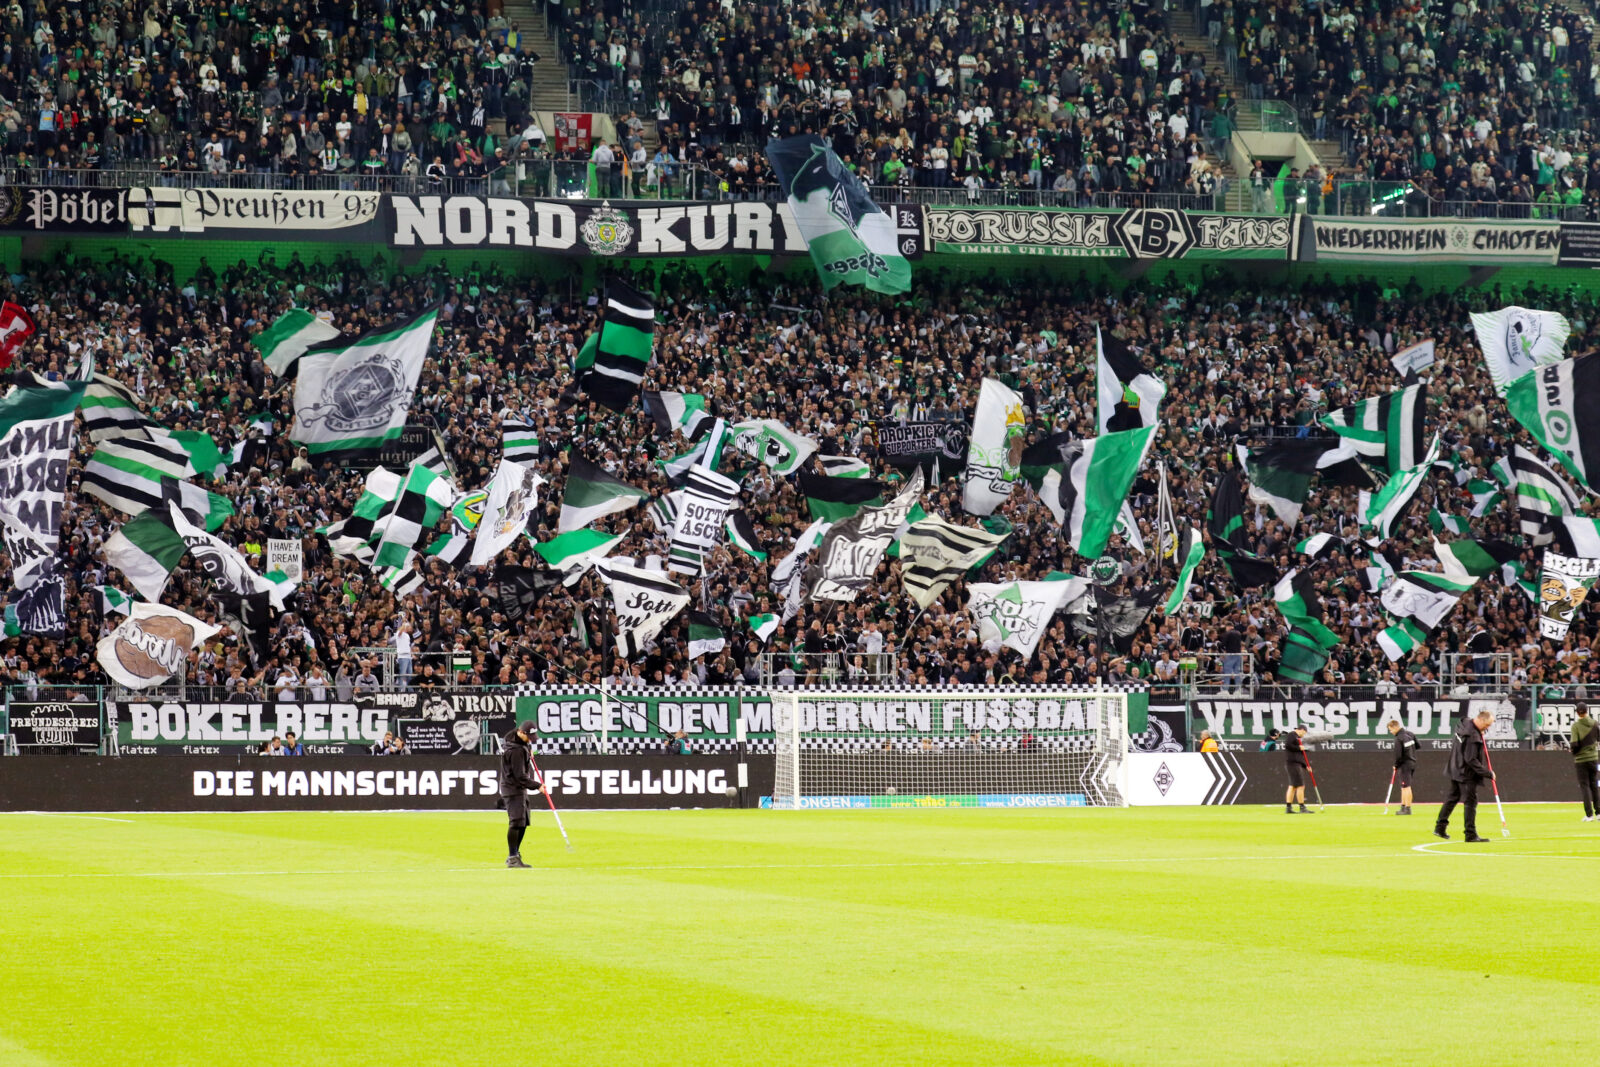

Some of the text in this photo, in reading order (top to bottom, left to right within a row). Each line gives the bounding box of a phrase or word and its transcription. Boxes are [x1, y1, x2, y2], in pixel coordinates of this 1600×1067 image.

[26, 189, 127, 229] Pöbel
[392, 195, 576, 249] NORD
[928, 210, 1290, 249] BORUSSIA FANS
[1316, 226, 1447, 250] NIEDERRHEIN
[1473, 229, 1562, 250] CHAOTEN
[960, 244, 1011, 254] IMMER
[1019, 247, 1046, 255] UND
[880, 424, 945, 443] DROPKICK
[886, 438, 937, 454] SUPPORTERS
[274, 543, 293, 551] HAVE
[295, 542, 300, 550] A
[272, 554, 299, 562] DREAM
[376, 693, 418, 706] BANDA
[451, 695, 516, 713] FRONT
[10, 717, 99, 727] FREUNDESKREIS
[128, 700, 389, 741] BÖKELBERG
[538, 701, 649, 734] GEGEN
[658, 702, 729, 735] DEN
[1198, 701, 1460, 736] VITUSSTADT
[120, 745, 157, 754] flatex
[183, 745, 220, 754] flatex
[307, 745, 344, 754] flatex
[1432, 740, 1452, 750] flat
[1487, 740, 1520, 749] flatex
[193, 770, 254, 797] DIE
[793, 797, 850, 808] ONGEN
[1007, 796, 1066, 807] JONGEN
